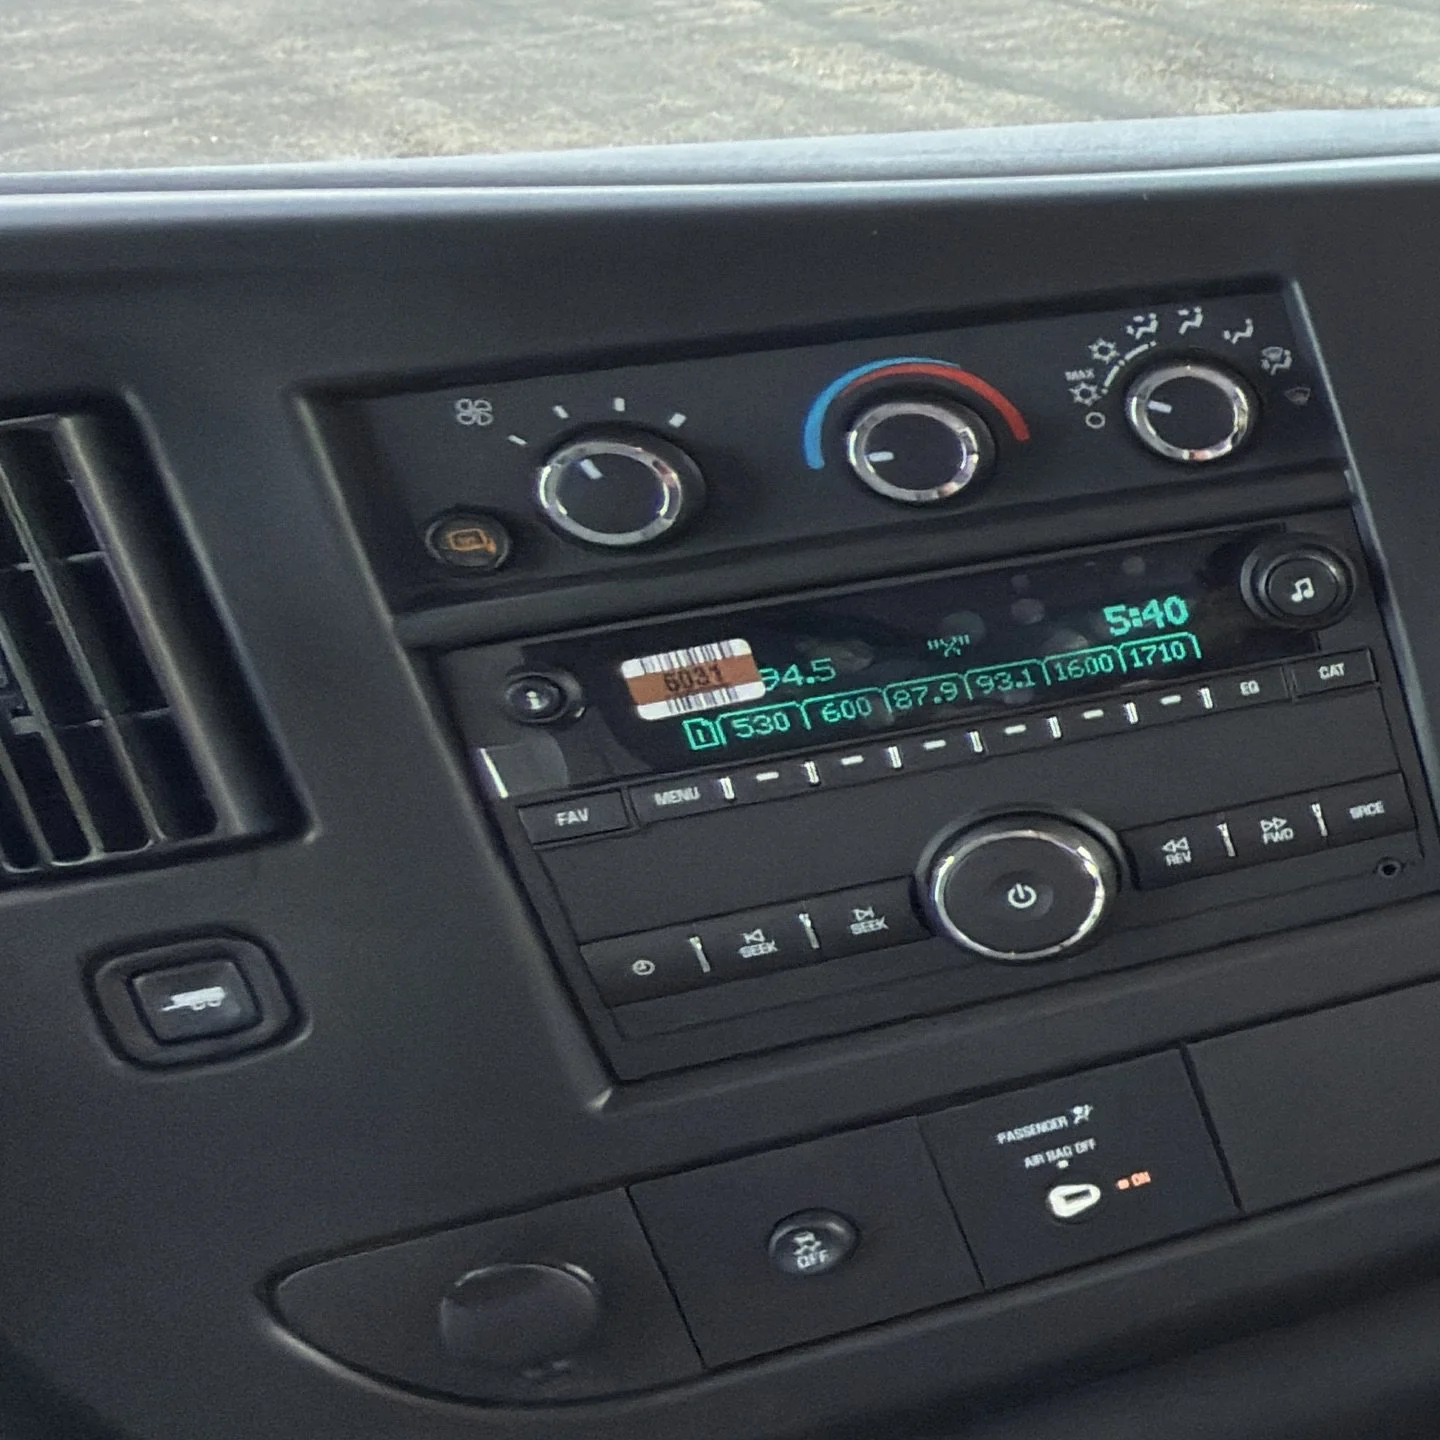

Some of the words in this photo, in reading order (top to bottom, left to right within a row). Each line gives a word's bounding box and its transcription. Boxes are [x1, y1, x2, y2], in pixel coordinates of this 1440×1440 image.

[1066, 368, 1095, 383] MAX
[1103, 595, 1190, 637] 5:40
[1318, 661, 1347, 681] CAT
[731, 712, 791, 738] 530
[821, 695, 873, 723] 600
[892, 681, 959, 710] 87.9
[976, 668, 1036, 695] 93.1
[1054, 653, 1115, 682] 1600
[1129, 641, 1187, 668] 1710
[653, 786, 700, 806] MENU
[555, 807, 589, 827] FAV
[1262, 826, 1295, 845] FWD
[1165, 848, 1192, 865] REV
[847, 915, 889, 936] SEEK
[738, 939, 779, 959] SEEK
[995, 1115, 1068, 1144] PASSENGER
[1024, 1152, 1045, 1169] AIR
[1046, 1146, 1073, 1162] BAG
[1075, 1138, 1096, 1154] OFF
